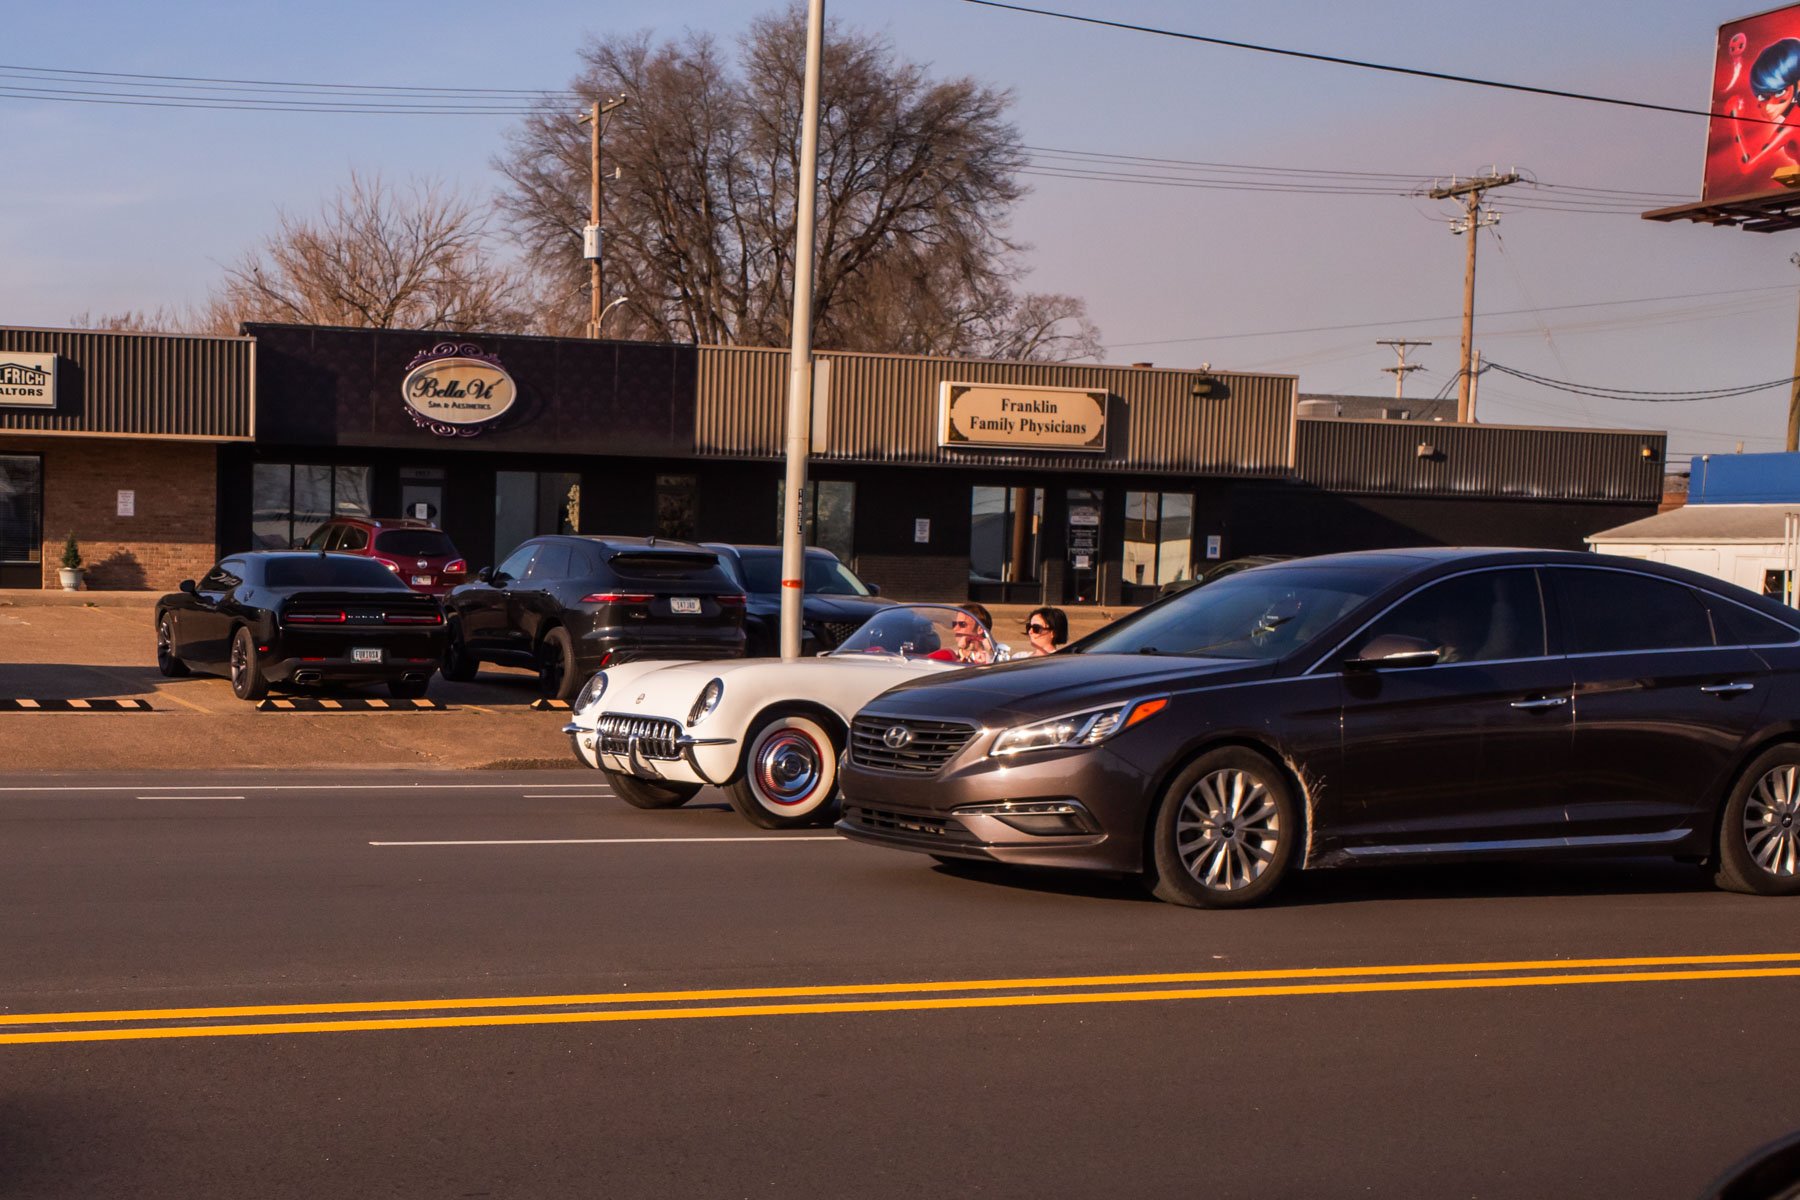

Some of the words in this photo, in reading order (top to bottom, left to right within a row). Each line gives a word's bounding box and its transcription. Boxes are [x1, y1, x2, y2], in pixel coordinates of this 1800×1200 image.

[412, 375, 466, 399] Bella
[1001, 398, 1058, 414] Franklin
[970, 415, 1015, 434] Family
[1020, 418, 1087, 435] Physicians
